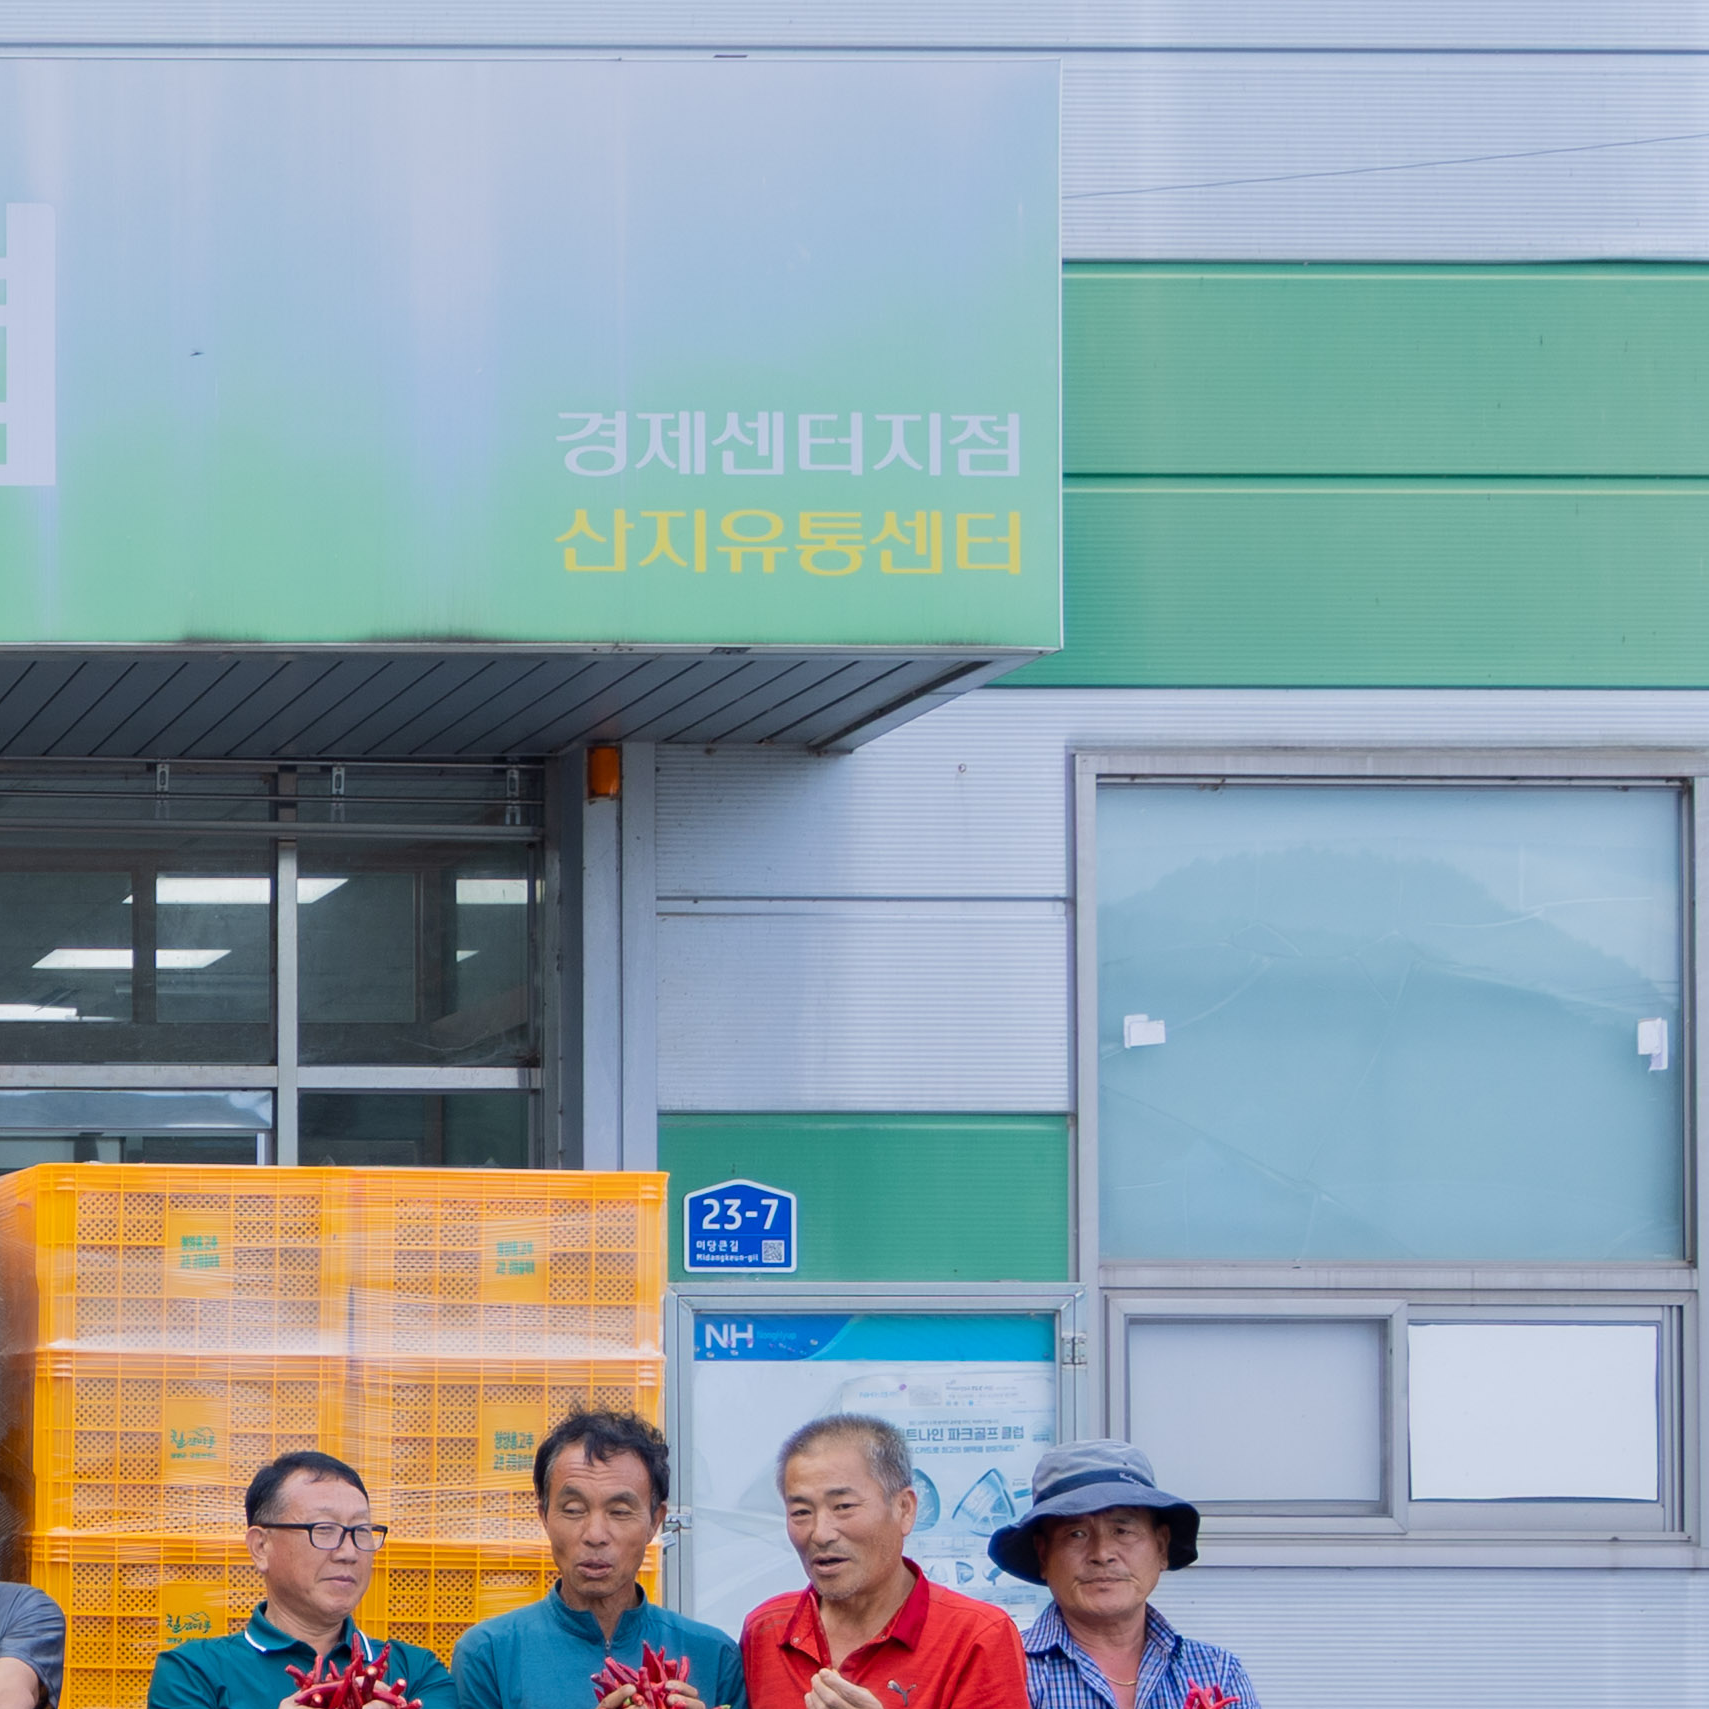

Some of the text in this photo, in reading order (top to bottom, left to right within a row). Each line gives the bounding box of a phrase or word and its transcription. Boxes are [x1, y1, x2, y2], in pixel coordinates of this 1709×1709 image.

[556, 411, 1020, 476] 경제센터지점
[555, 509, 1020, 576] 산지유통센터
[702, 1198, 779, 1230] 23-7
[696, 1240, 739, 1253] 미당큰길
[705, 1323, 754, 1349] NH
[947, 1427, 999, 1441] 파크골프
